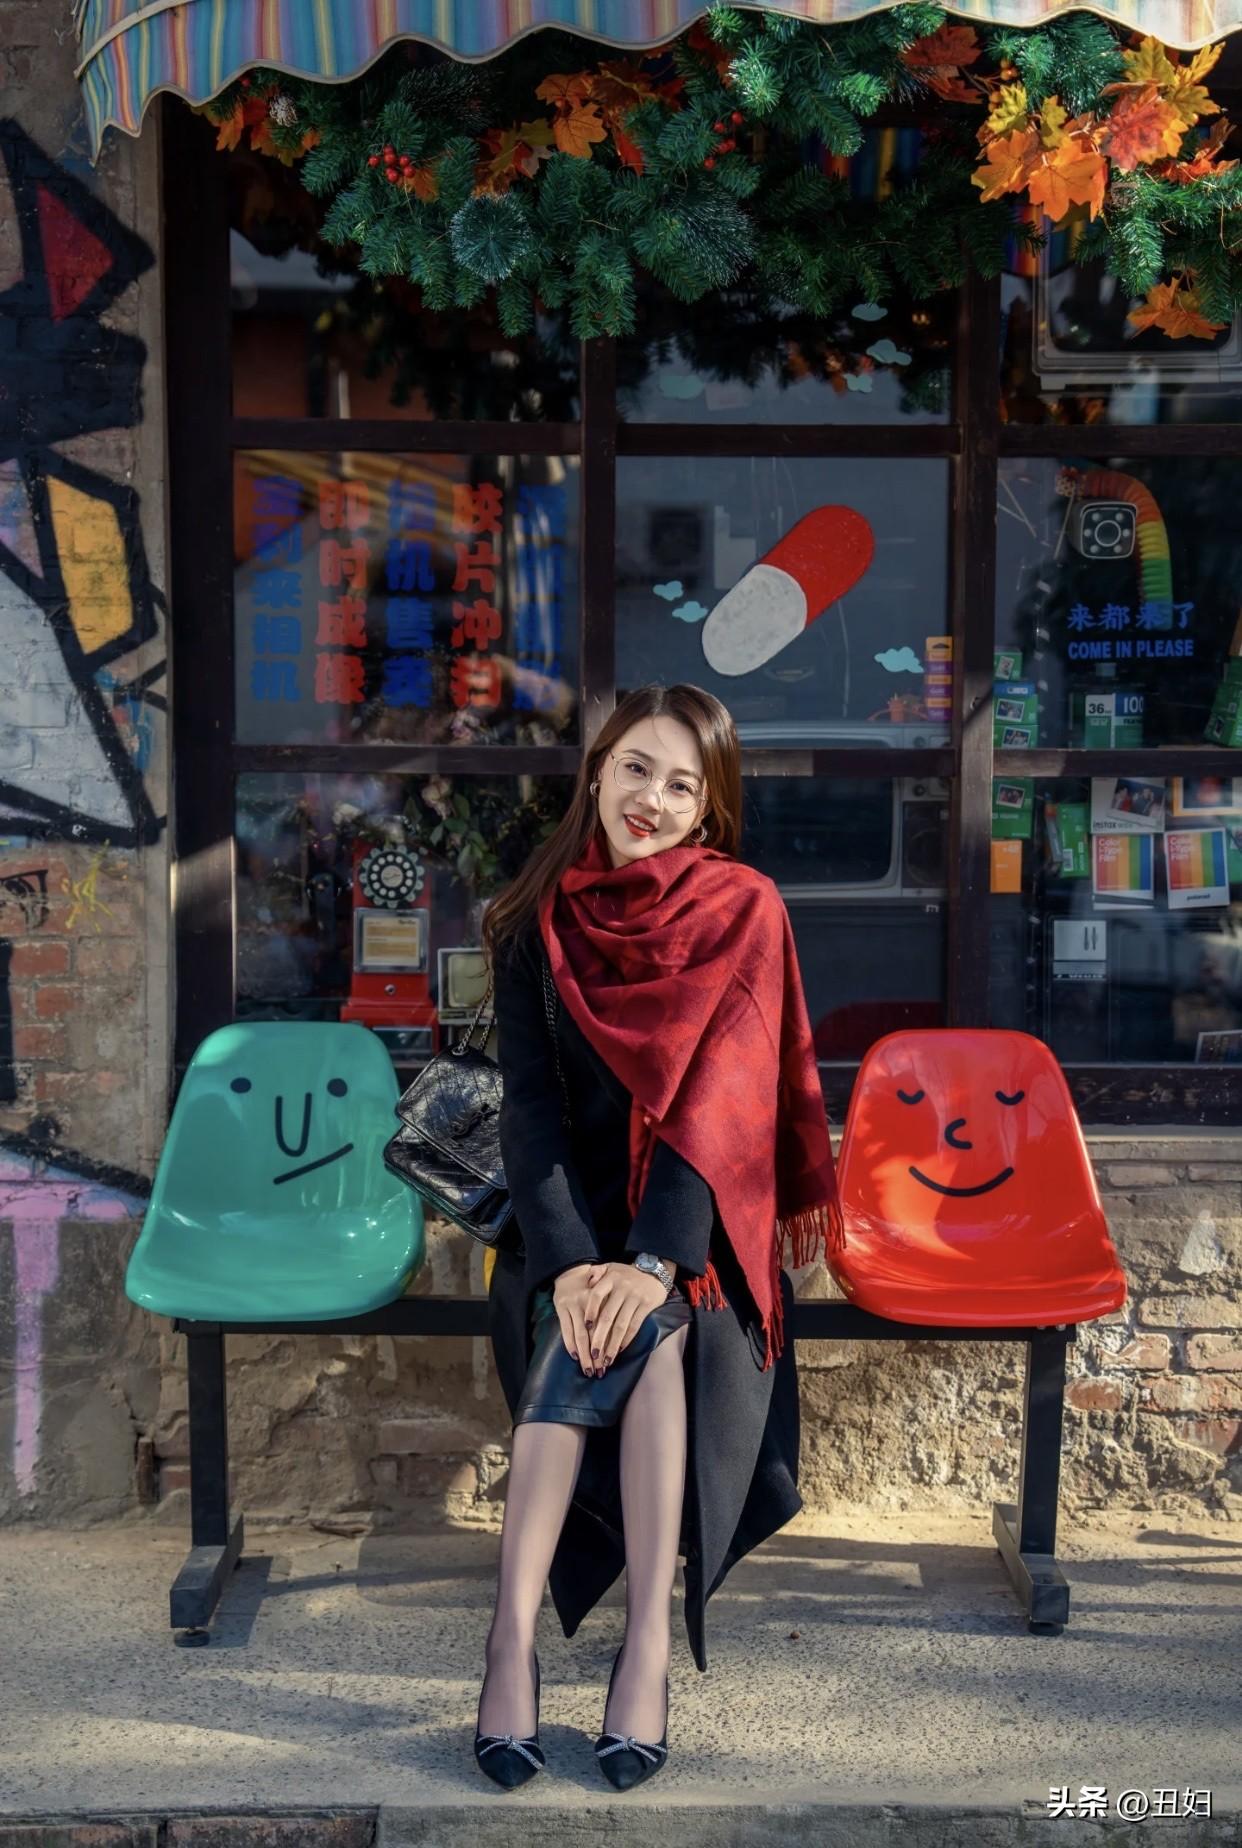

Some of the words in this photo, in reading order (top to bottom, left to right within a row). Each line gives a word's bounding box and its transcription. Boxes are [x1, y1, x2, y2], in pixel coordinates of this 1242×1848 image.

[451, 481, 503, 709] 胶片冲扫
[1067, 601, 1195, 632] 来都来了
[1068, 640, 1112, 659] COME
[1116, 640, 1133, 658] IN
[1136, 639, 1194, 657] PLEASE
[1088, 703, 1105, 714] 36
